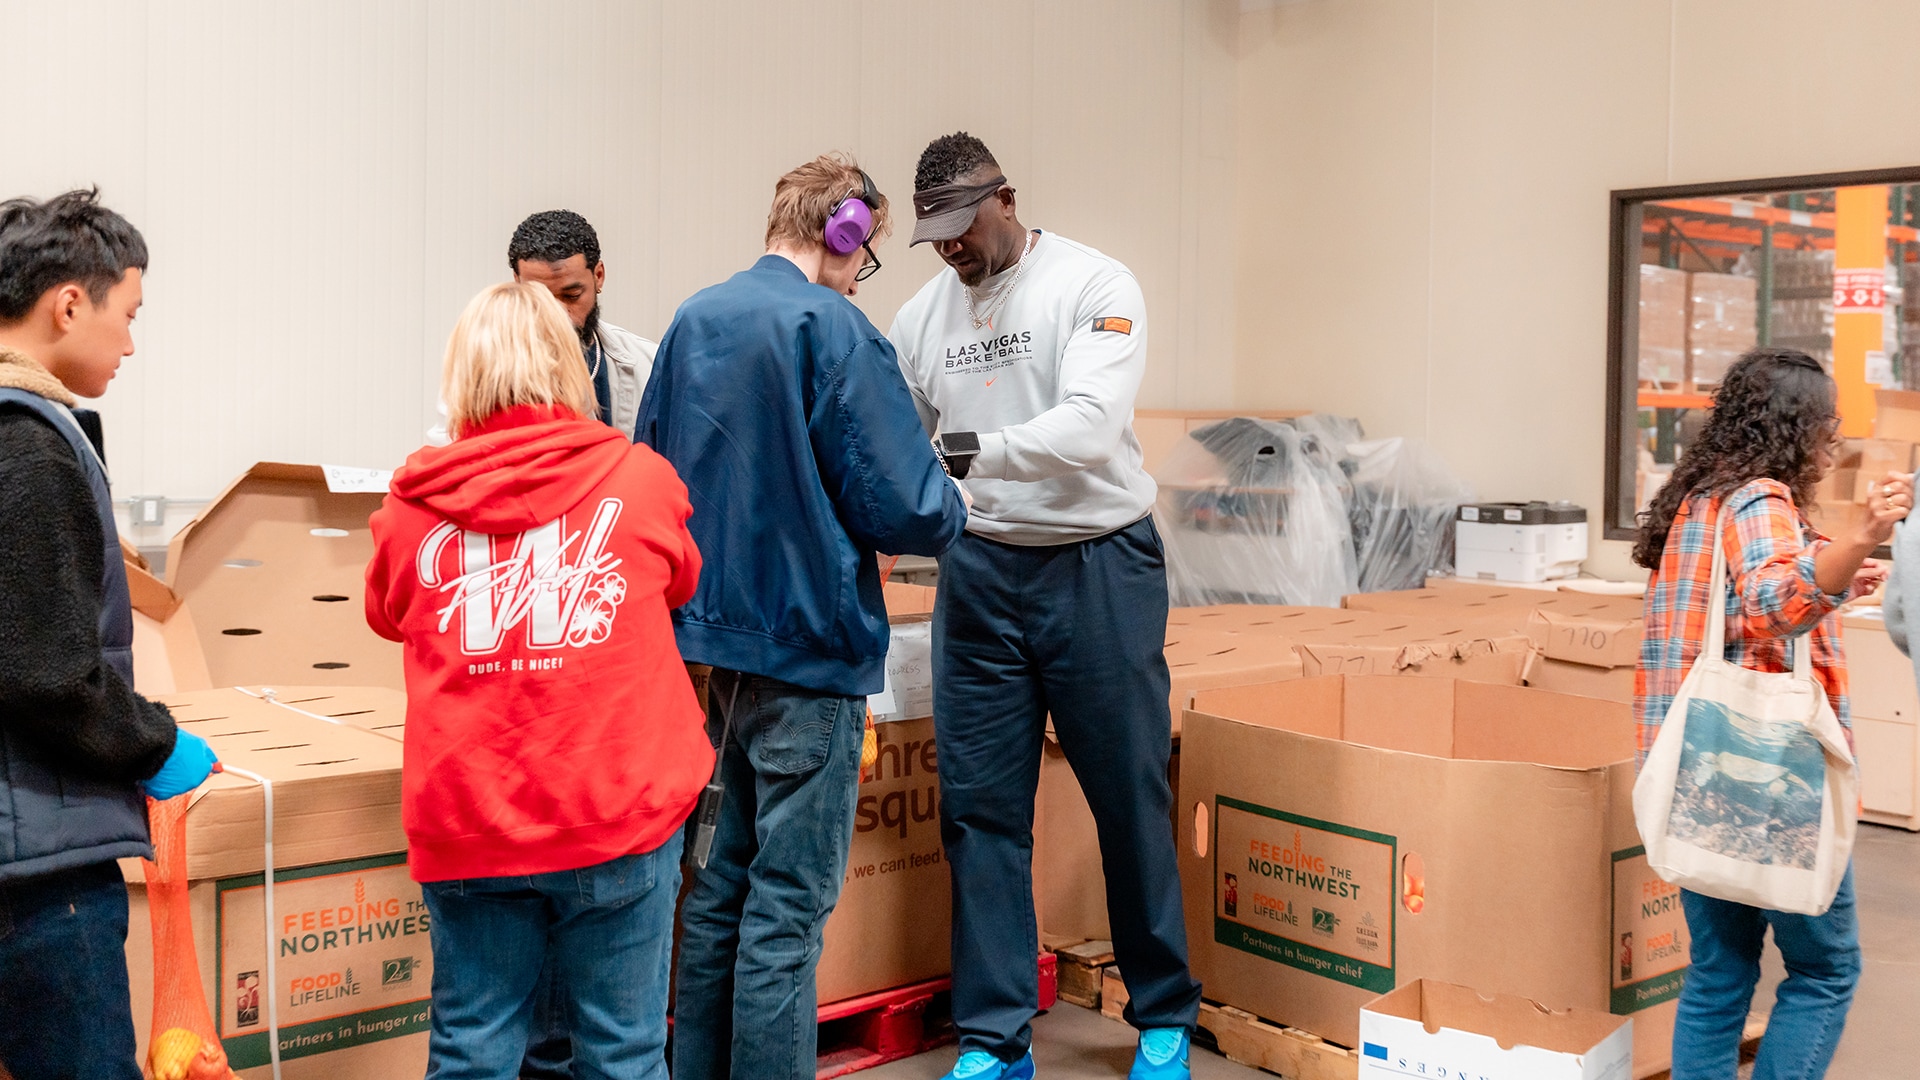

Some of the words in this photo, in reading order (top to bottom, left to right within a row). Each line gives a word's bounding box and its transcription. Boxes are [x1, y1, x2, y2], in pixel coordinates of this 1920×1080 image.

[945, 345, 1032, 368] BASKEBALL
[946, 343, 978, 359] LAS
[980, 331, 1032, 352] VEGAS
[1561, 626, 1607, 650] 770
[468, 661, 506, 675] DUDE,
[511, 658, 524, 671] BE
[529, 656, 563, 671] NICE!
[863, 733, 939, 784] hre
[856, 786, 942, 839] squ
[854, 864, 875, 878] we
[880, 858, 906, 874] can
[910, 848, 940, 868] feed
[1250, 836, 1325, 873] FEEDING
[1329, 865, 1352, 880] THE
[1248, 857, 1360, 901] NORTHWEST
[284, 894, 400, 934] FEEDING
[406, 900, 425, 913] TH
[1253, 892, 1285, 912] FOOD
[1254, 904, 1299, 927] LIFELINE
[281, 914, 430, 957] NORTHWES
[1242, 932, 1282, 954] Partners
[1284, 946, 1294, 958] in
[1296, 948, 1332, 970] hunger
[1335, 962, 1363, 979] relief
[290, 972, 342, 994] FOOD
[290, 982, 361, 1007] LIFELINE
[278, 1030, 334, 1051] artners
[338, 1026, 352, 1039] in
[357, 1016, 408, 1035] hunger
[412, 1005, 432, 1023] rel
